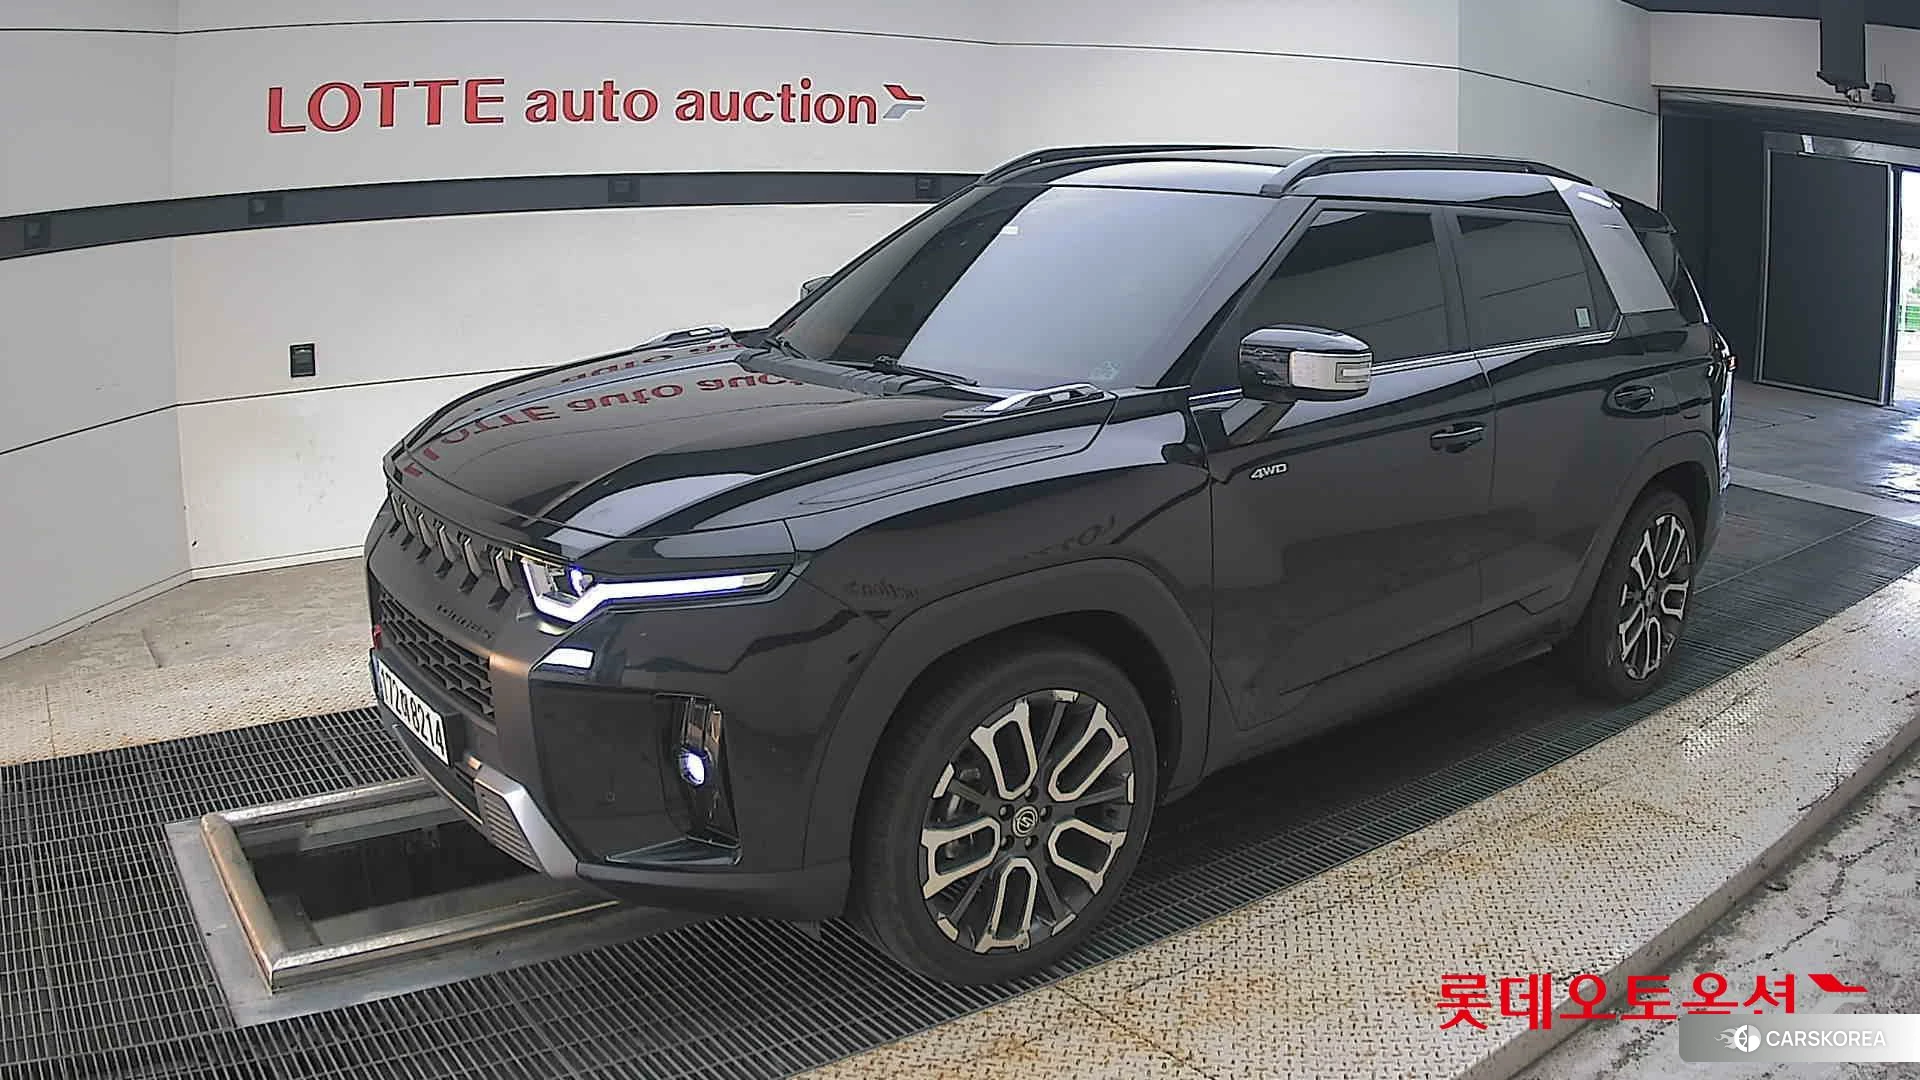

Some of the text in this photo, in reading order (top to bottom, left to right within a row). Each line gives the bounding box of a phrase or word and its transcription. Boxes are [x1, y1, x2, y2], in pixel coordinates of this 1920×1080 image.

[268, 78, 877, 133] LOTTE auto auction
[1250, 463, 1287, 479] 4WD
